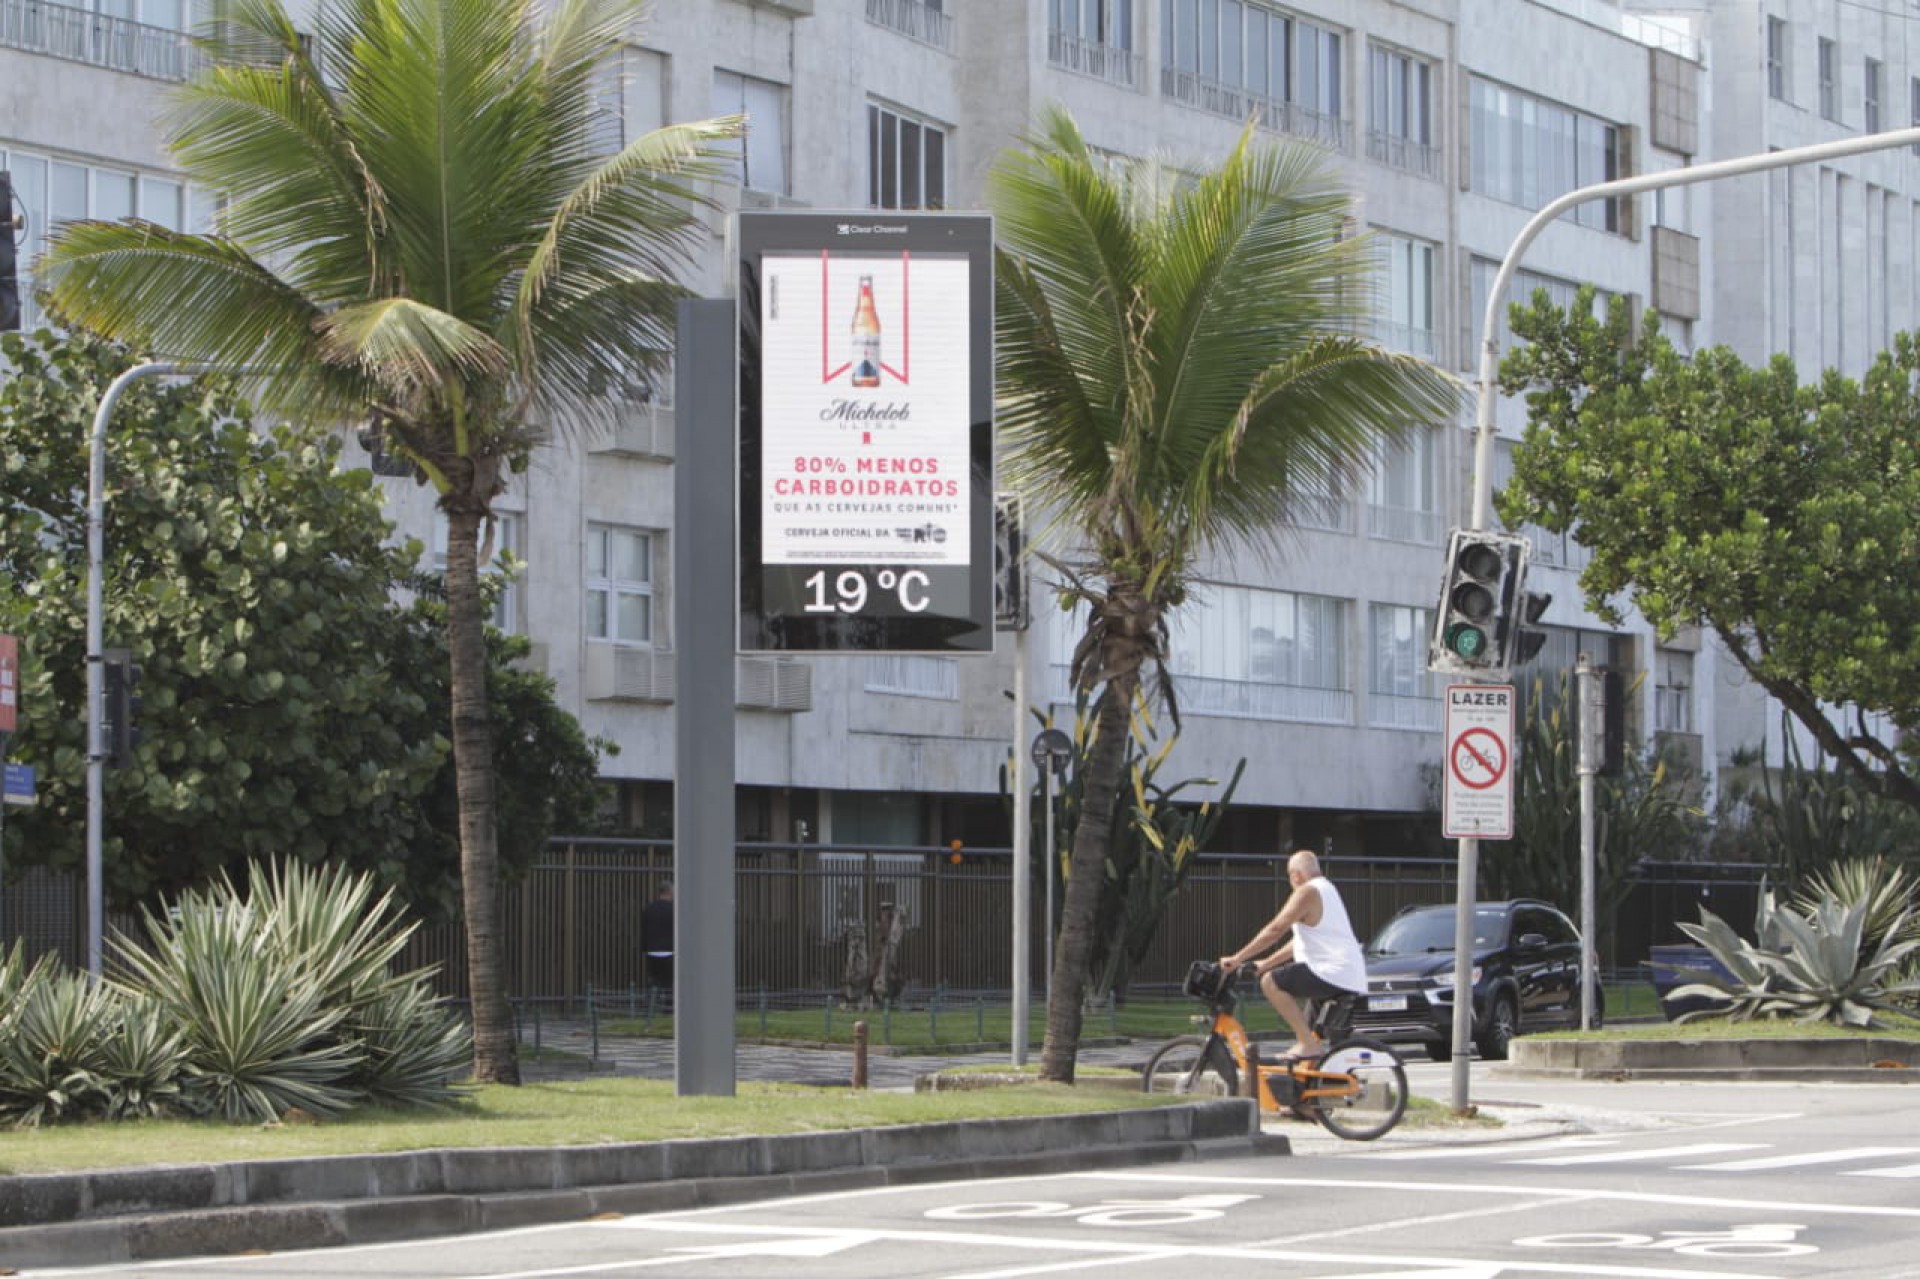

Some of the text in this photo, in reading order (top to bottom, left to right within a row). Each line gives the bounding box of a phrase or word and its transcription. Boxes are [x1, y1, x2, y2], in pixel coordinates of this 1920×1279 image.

[819, 399, 910, 421] Michelob
[794, 457, 938, 473] 80% MENOS
[774, 478, 958, 496] CARBOIDRATOS
[774, 503, 800, 513] QUE
[805, 503, 821, 512] AS
[827, 503, 892, 512] CERVEJAS
[784, 528, 829, 537] CERVEJA
[832, 528, 871, 537] OFICIAL
[875, 528, 889, 537] DA
[804, 570, 868, 612] 19
[1452, 693, 1507, 706] LAZER
